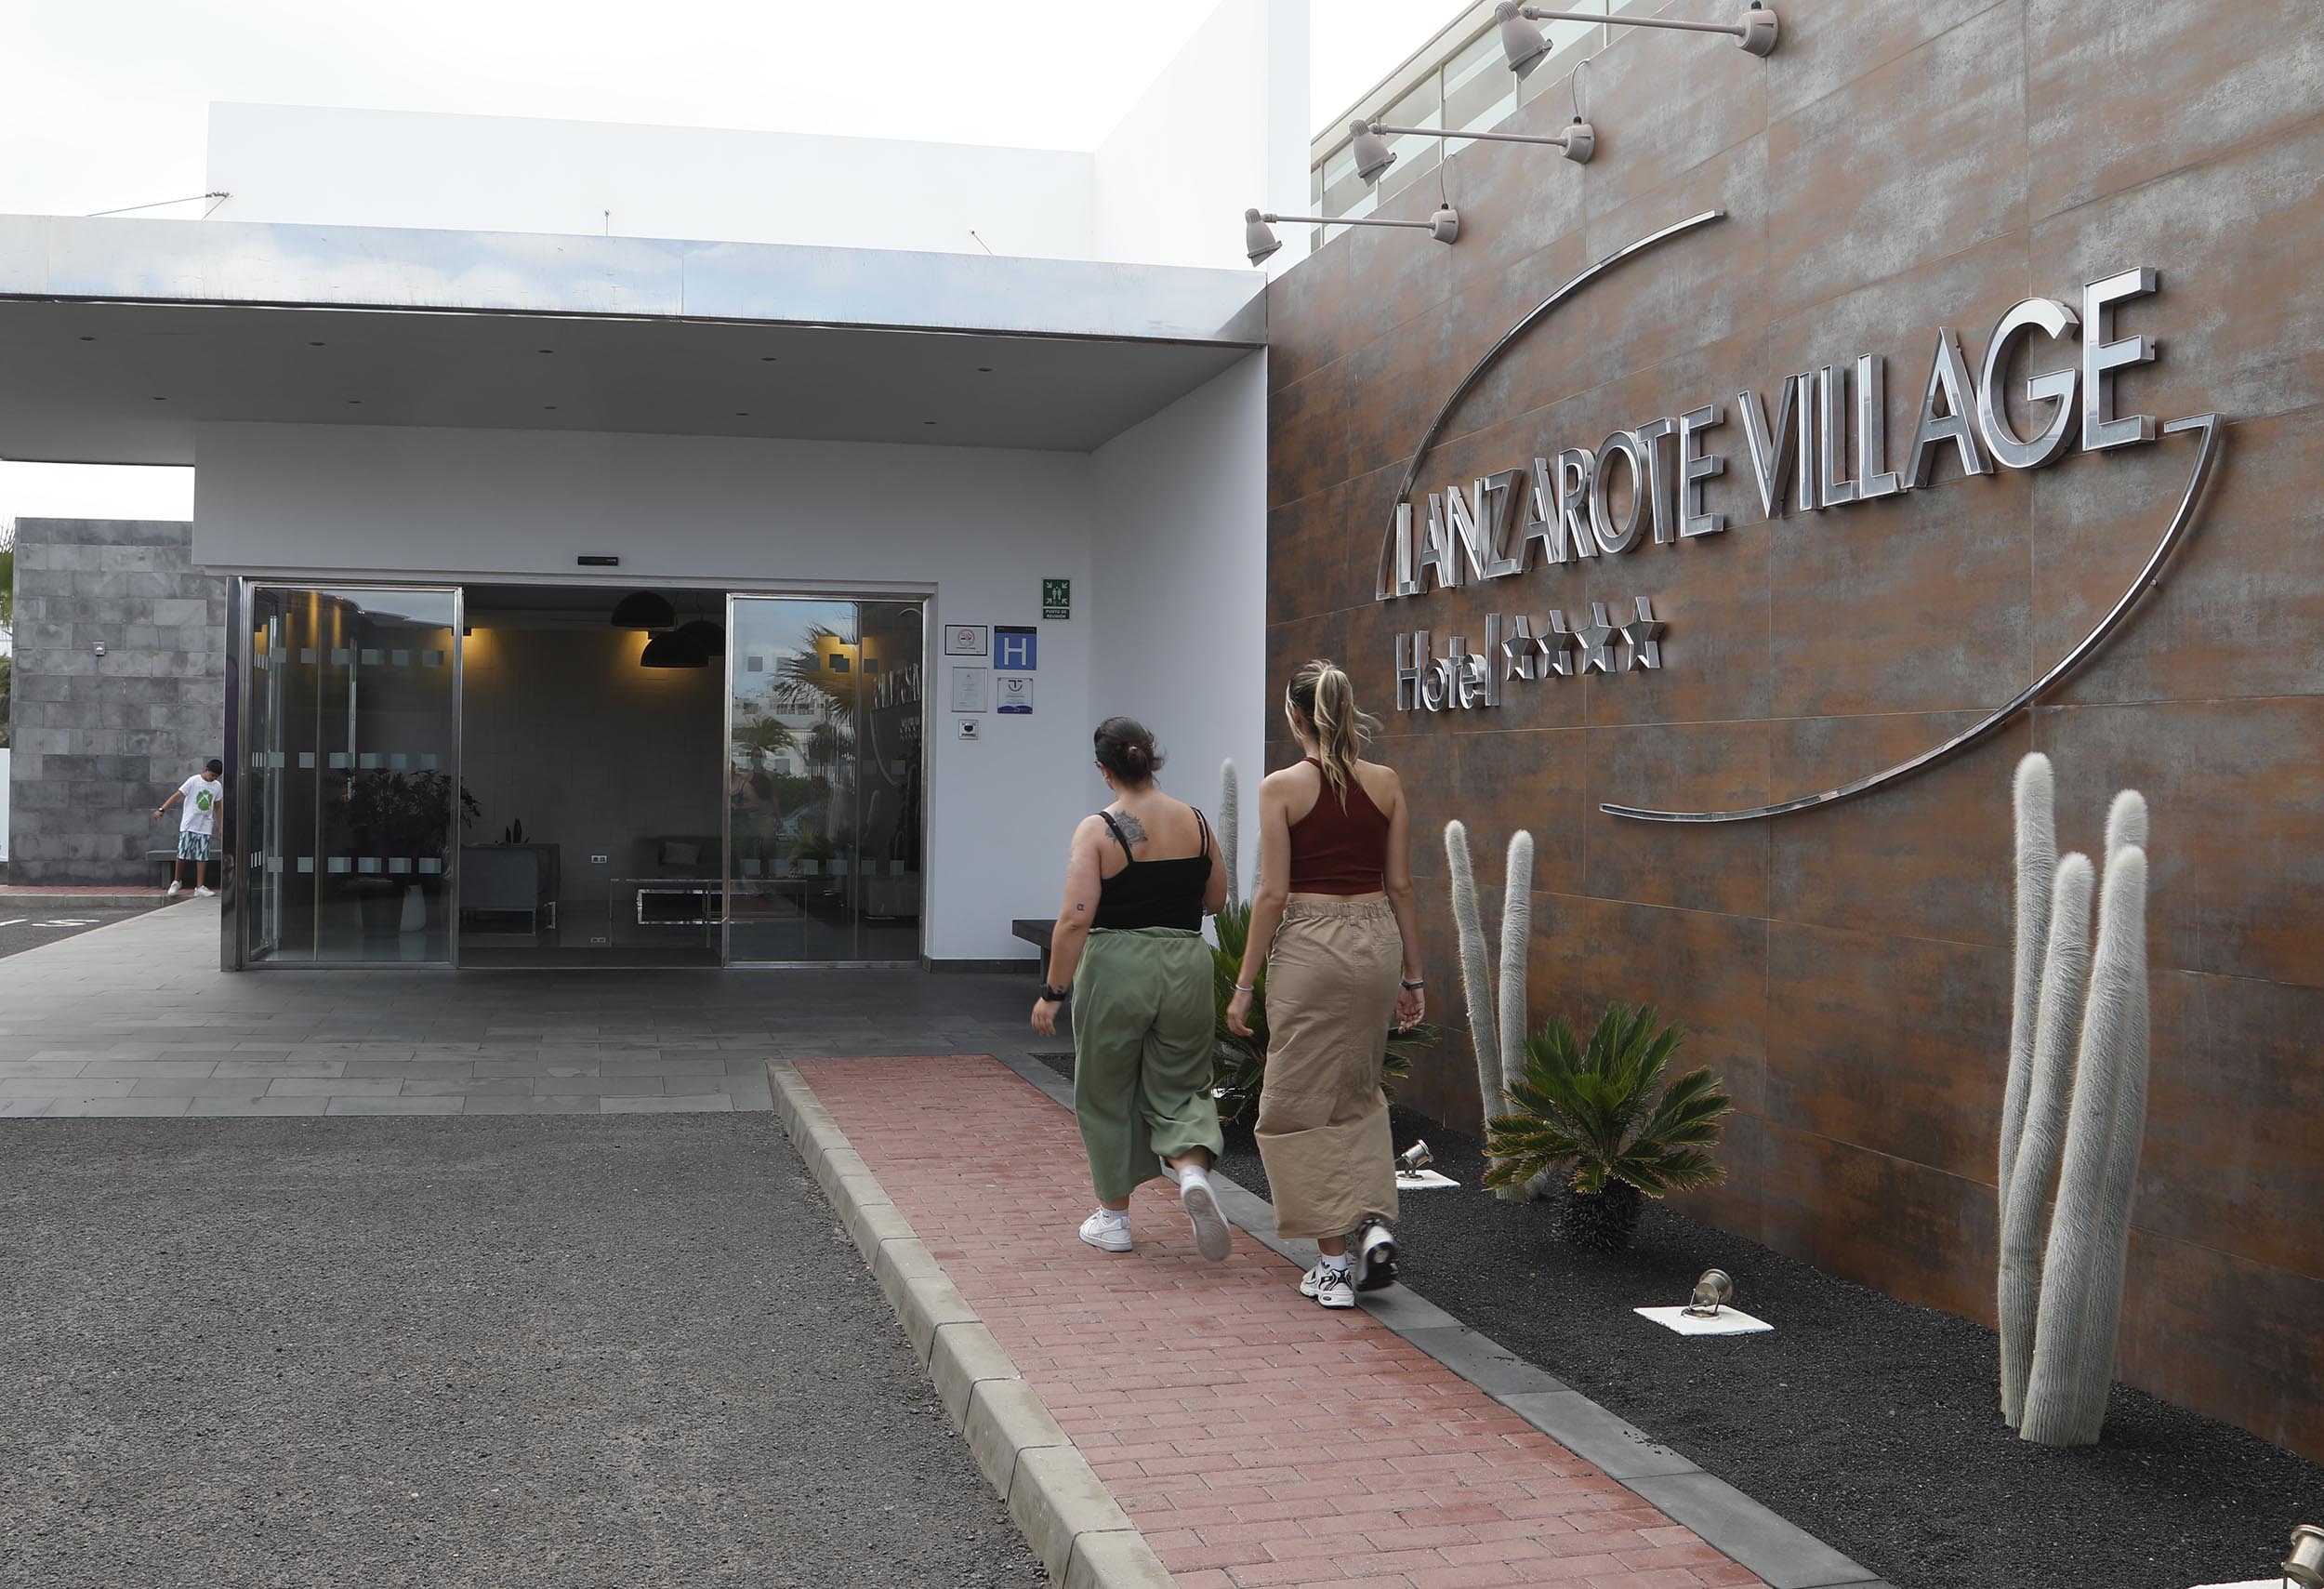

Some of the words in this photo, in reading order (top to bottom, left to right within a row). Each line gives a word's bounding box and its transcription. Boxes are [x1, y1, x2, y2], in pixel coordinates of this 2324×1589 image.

[1395, 404, 1724, 598] LANZAROTE
[1737, 265, 2157, 520] VILLAGE
[1004, 637, 1026, 666] H
[1395, 614, 1501, 712] Hotel
